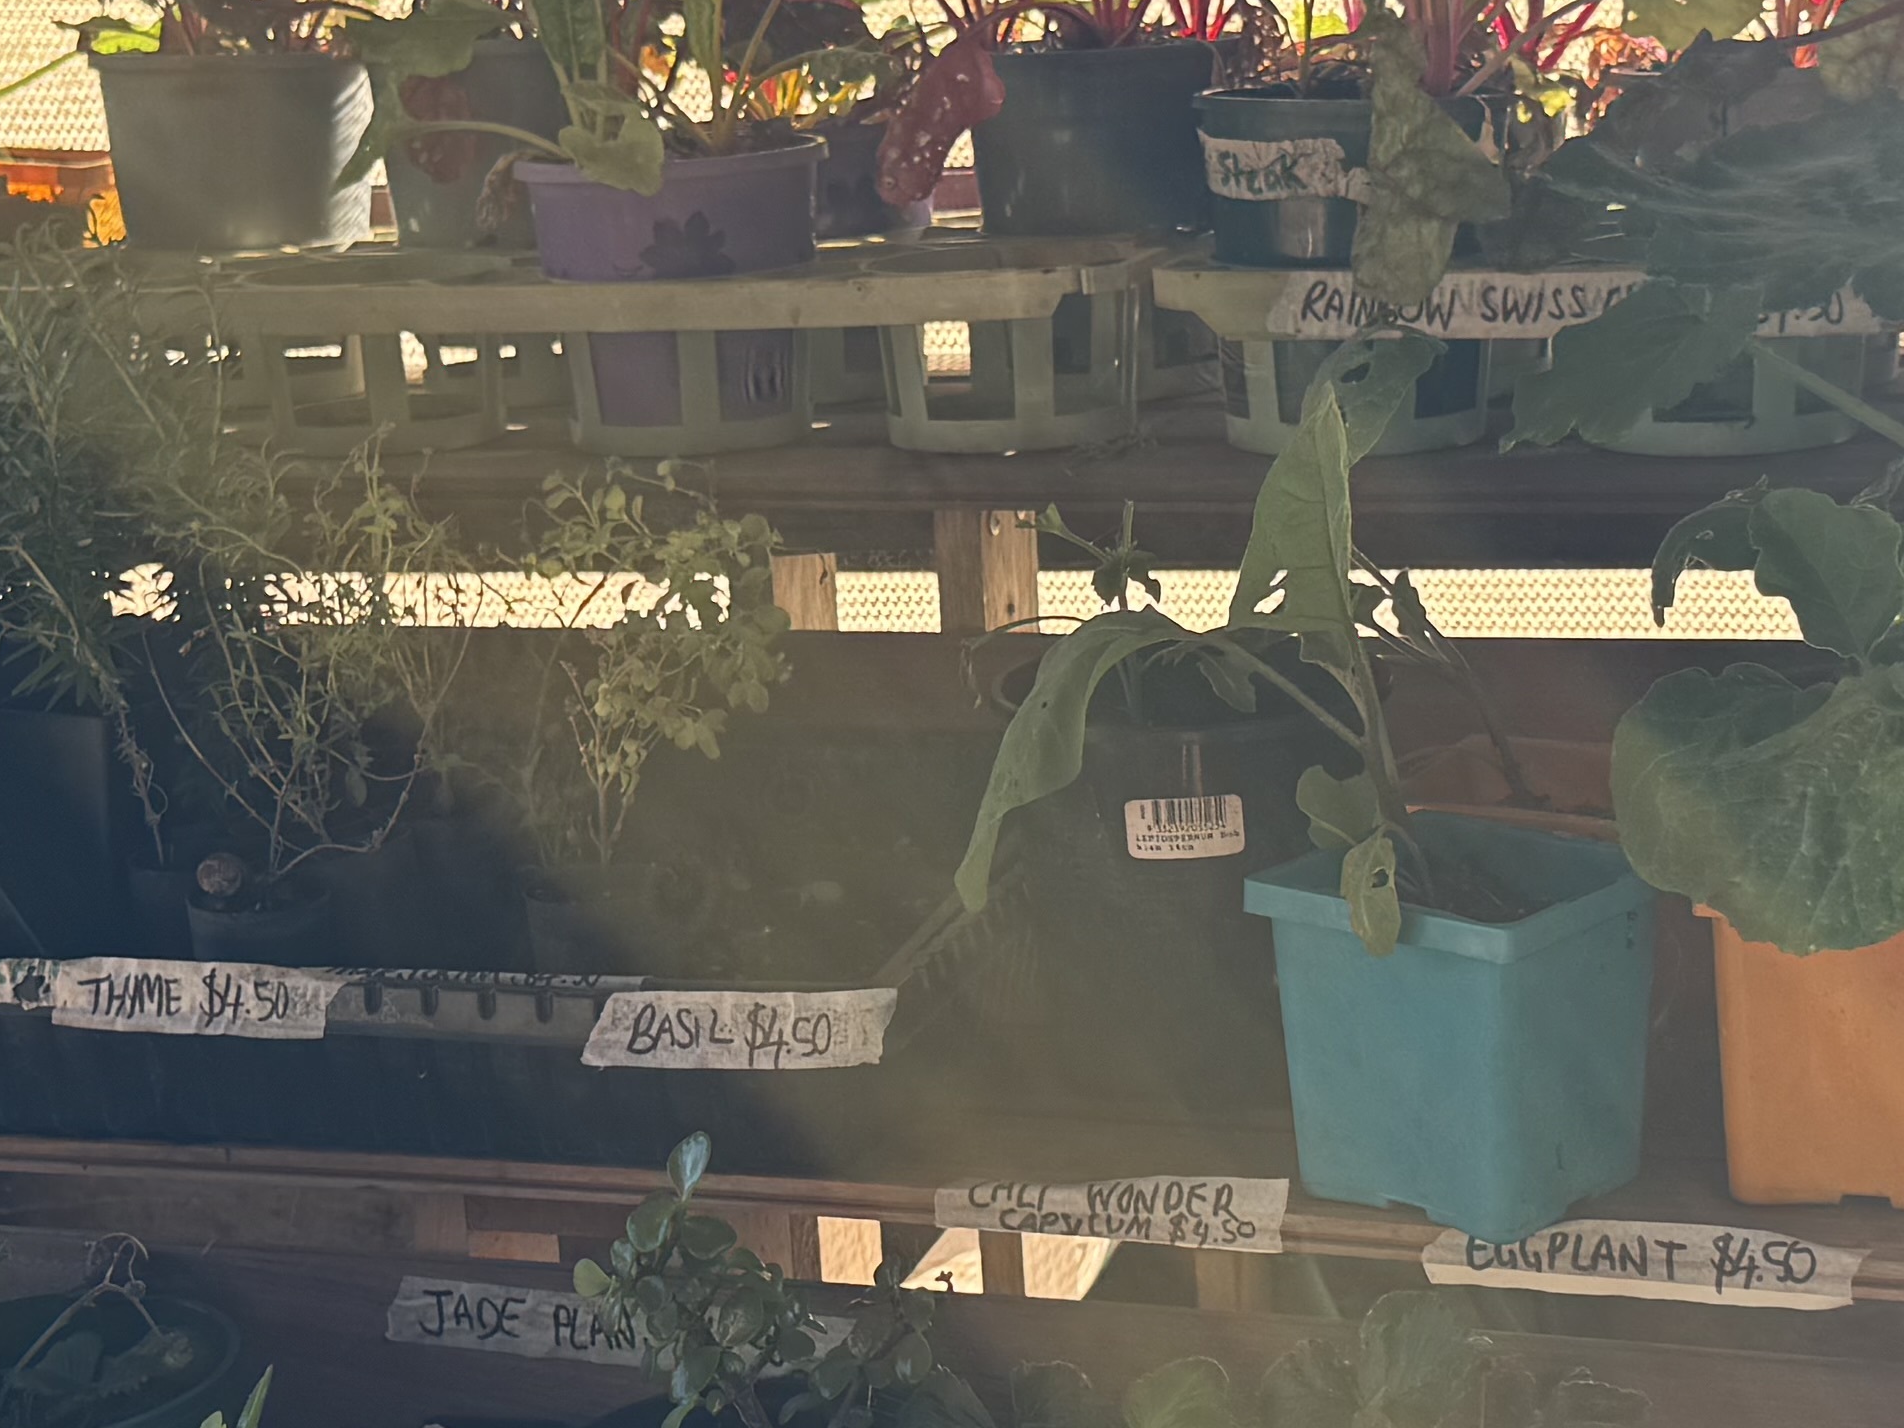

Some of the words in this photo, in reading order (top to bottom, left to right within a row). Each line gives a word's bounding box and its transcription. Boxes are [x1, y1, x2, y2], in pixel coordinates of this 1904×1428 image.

[1301, 280, 1456, 332] RAINOW
[1480, 284, 1586, 325] SWISS
[77, 976, 182, 1020] THYME
[201, 972, 291, 1023] $4.50
[626, 1002, 734, 1056] BASIL
[744, 1002, 833, 1069] $4.50
[1086, 1180, 1242, 1223] WONDER
[1167, 1215, 1256, 1248] $4.50
[1711, 1232, 1817, 1295] $4.50
[417, 1289, 527, 1340] JADE
[553, 1300, 648, 1351] PLAN
